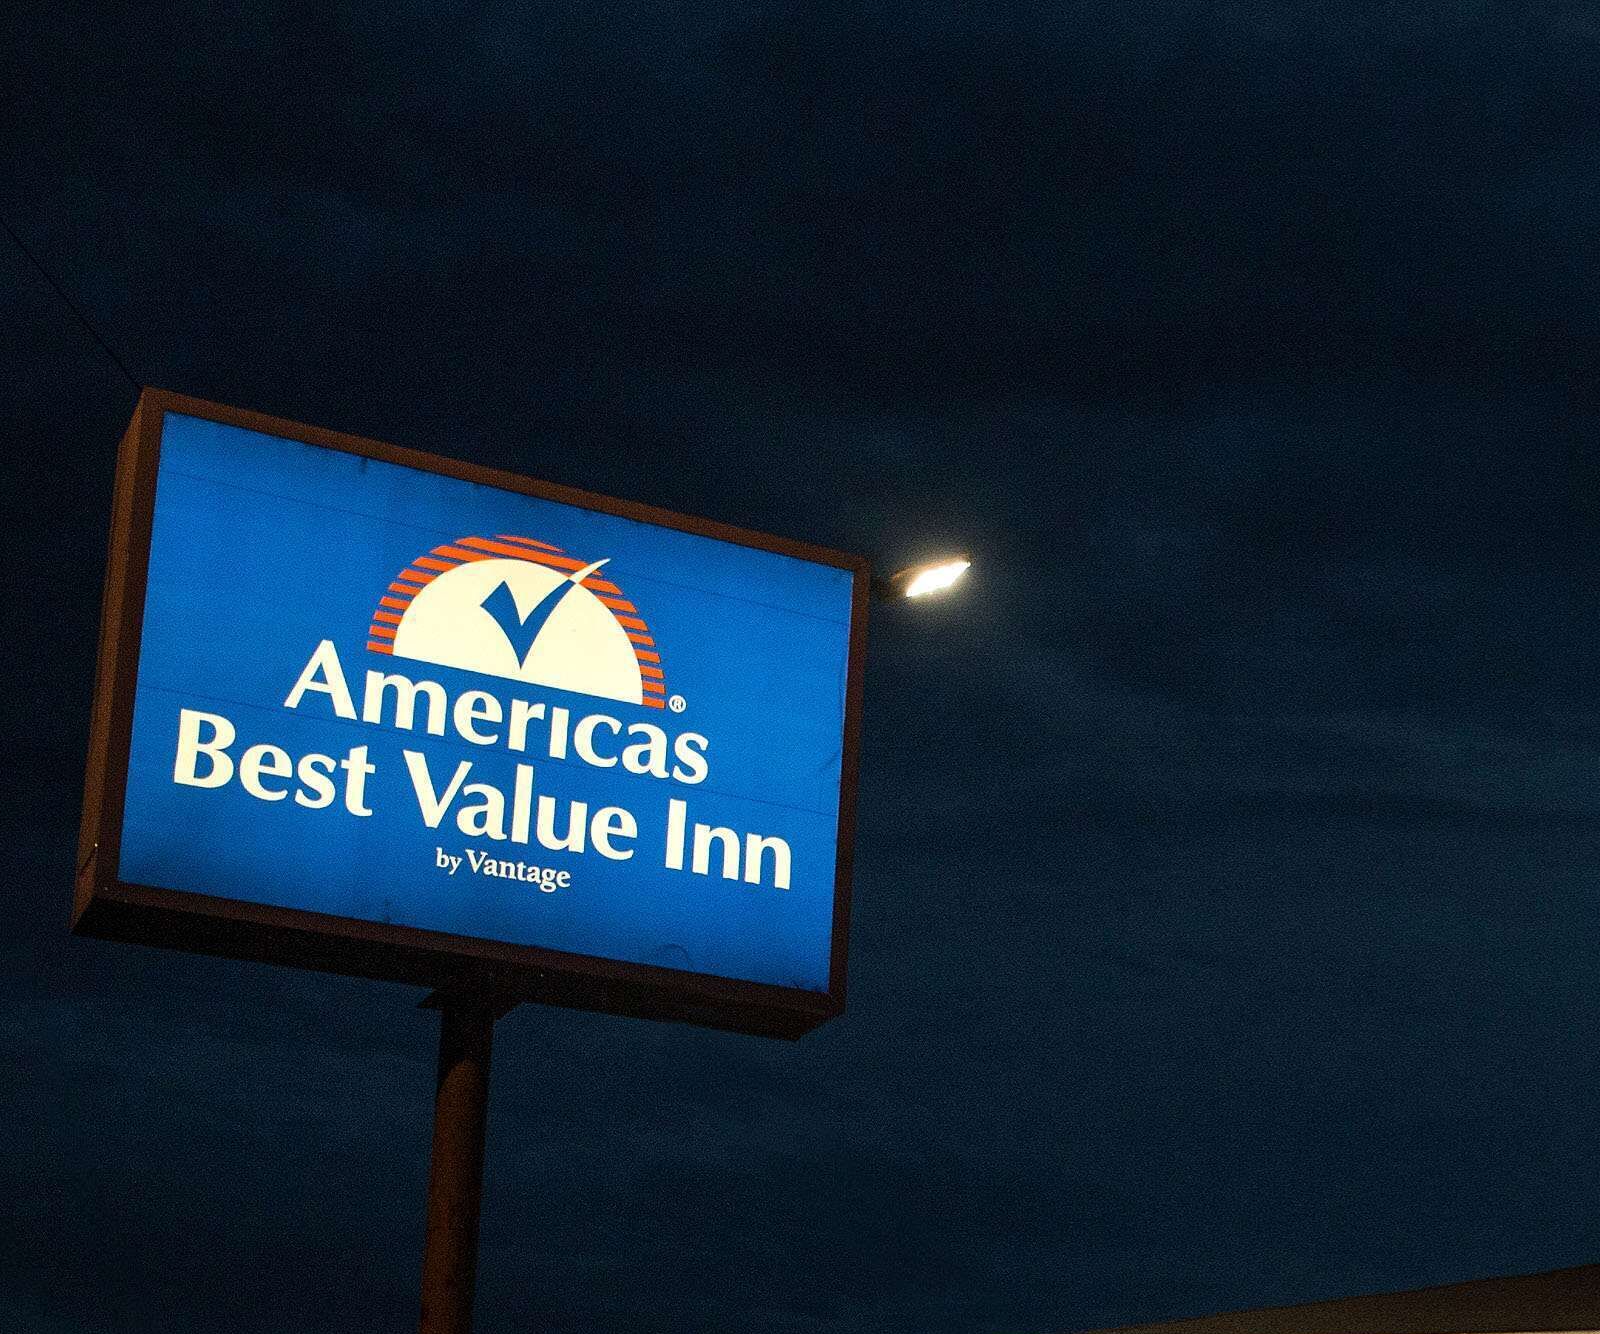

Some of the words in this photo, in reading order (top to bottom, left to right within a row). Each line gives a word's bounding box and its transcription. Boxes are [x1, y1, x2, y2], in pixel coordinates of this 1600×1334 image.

[283, 639, 709, 785] Americas
[173, 708, 376, 817] Best
[402, 749, 638, 861] Value
[665, 798, 792, 890] Inn
[436, 847, 463, 875] by
[465, 848, 572, 893] Vantage
